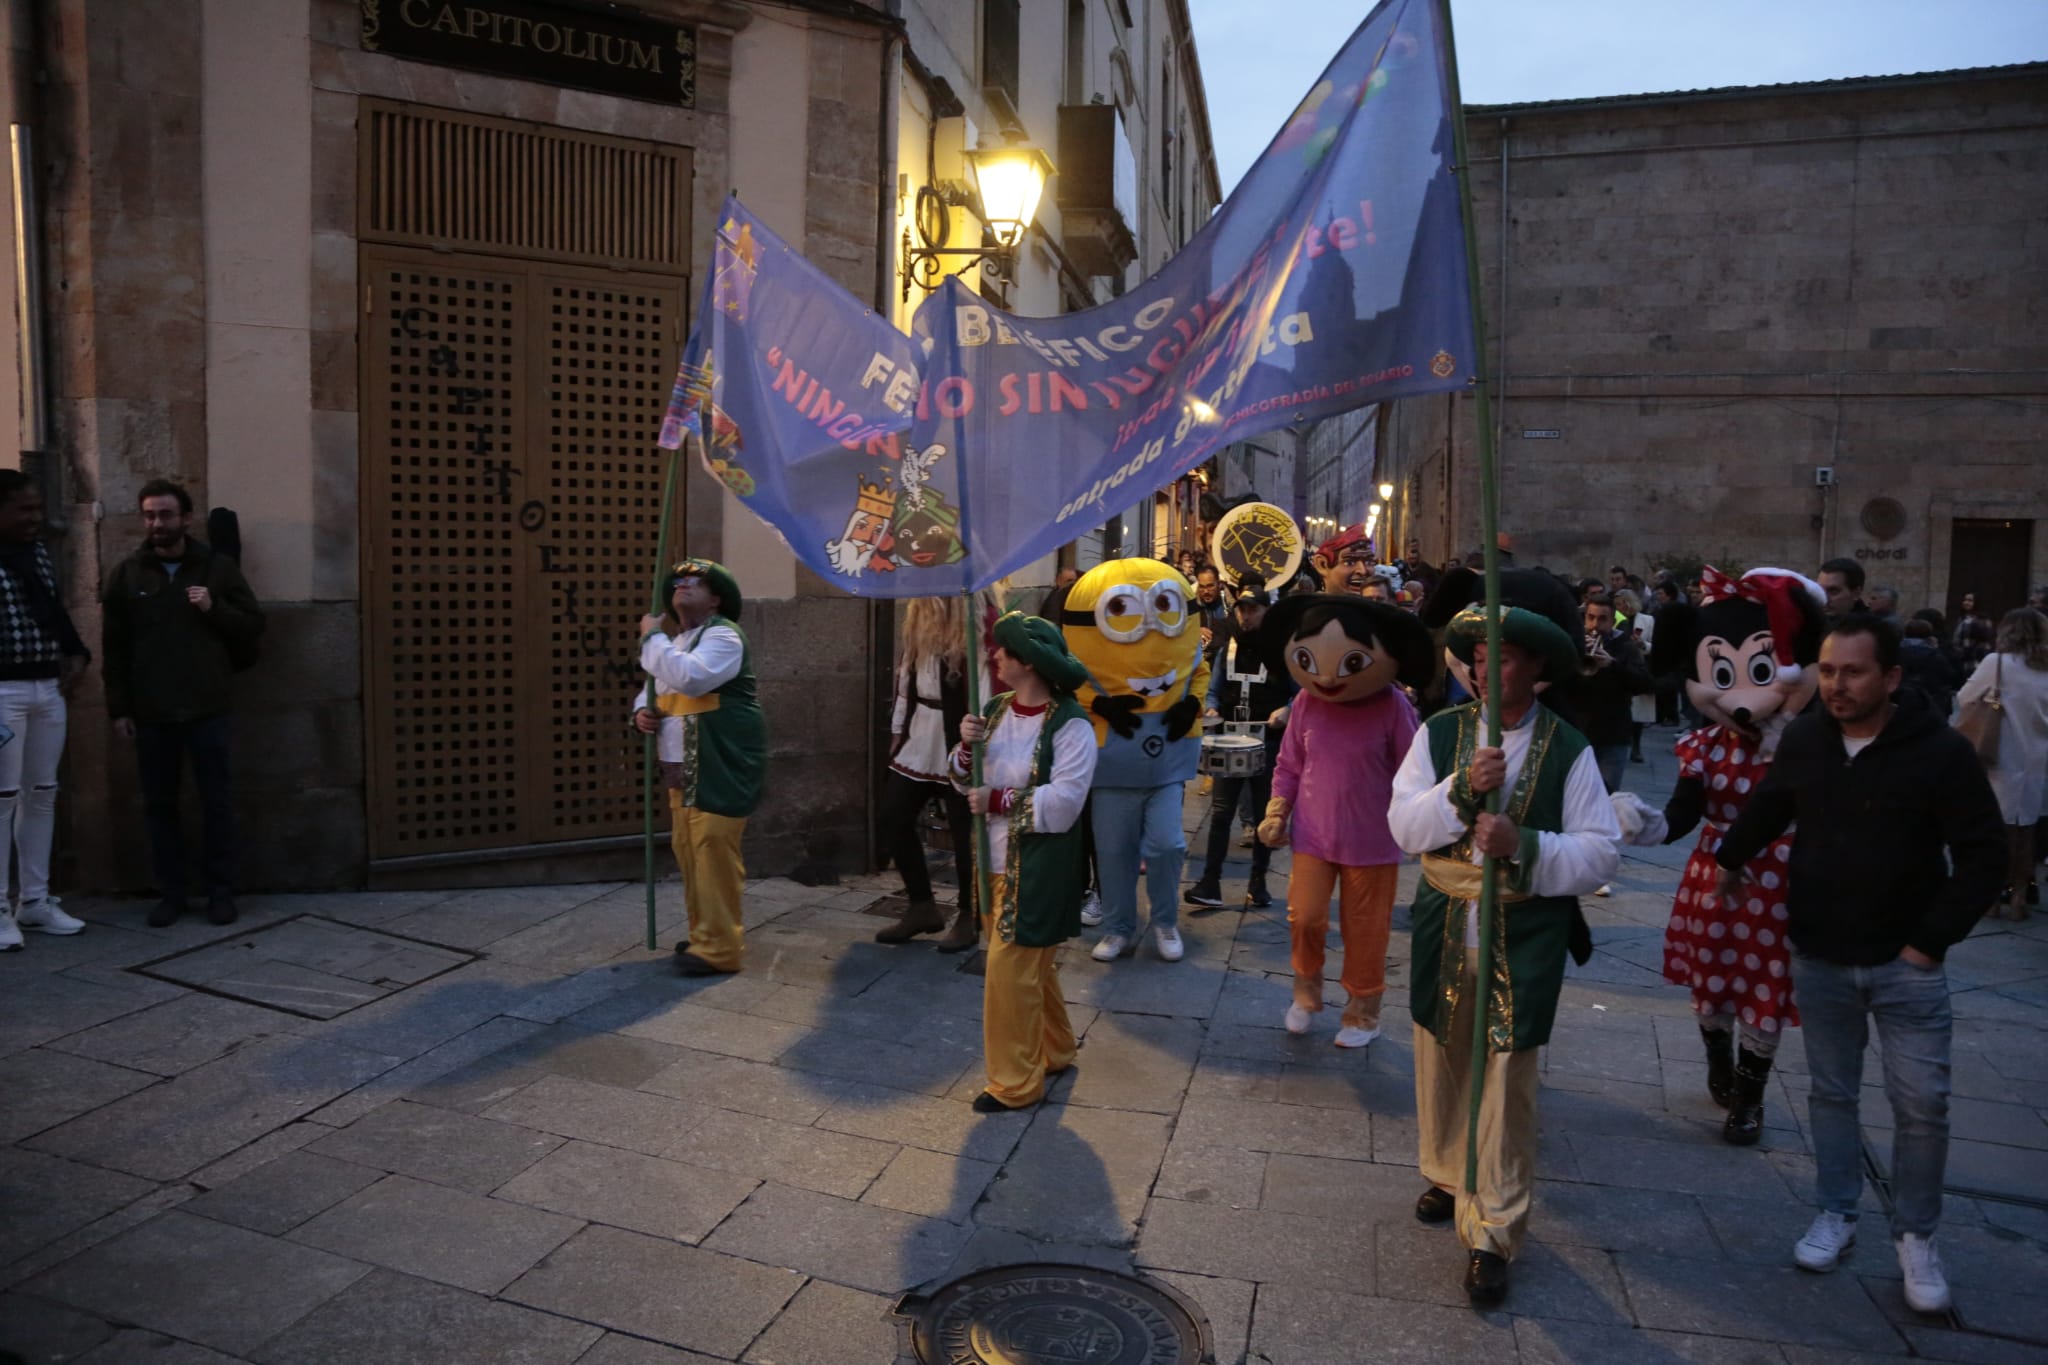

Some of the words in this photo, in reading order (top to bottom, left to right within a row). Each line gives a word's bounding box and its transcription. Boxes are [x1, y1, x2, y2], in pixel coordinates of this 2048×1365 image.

[401, 0, 663, 74] CAPITOLIUM
[1000, 371, 1088, 416] SIN
[1055, 435, 1166, 524] entrada
